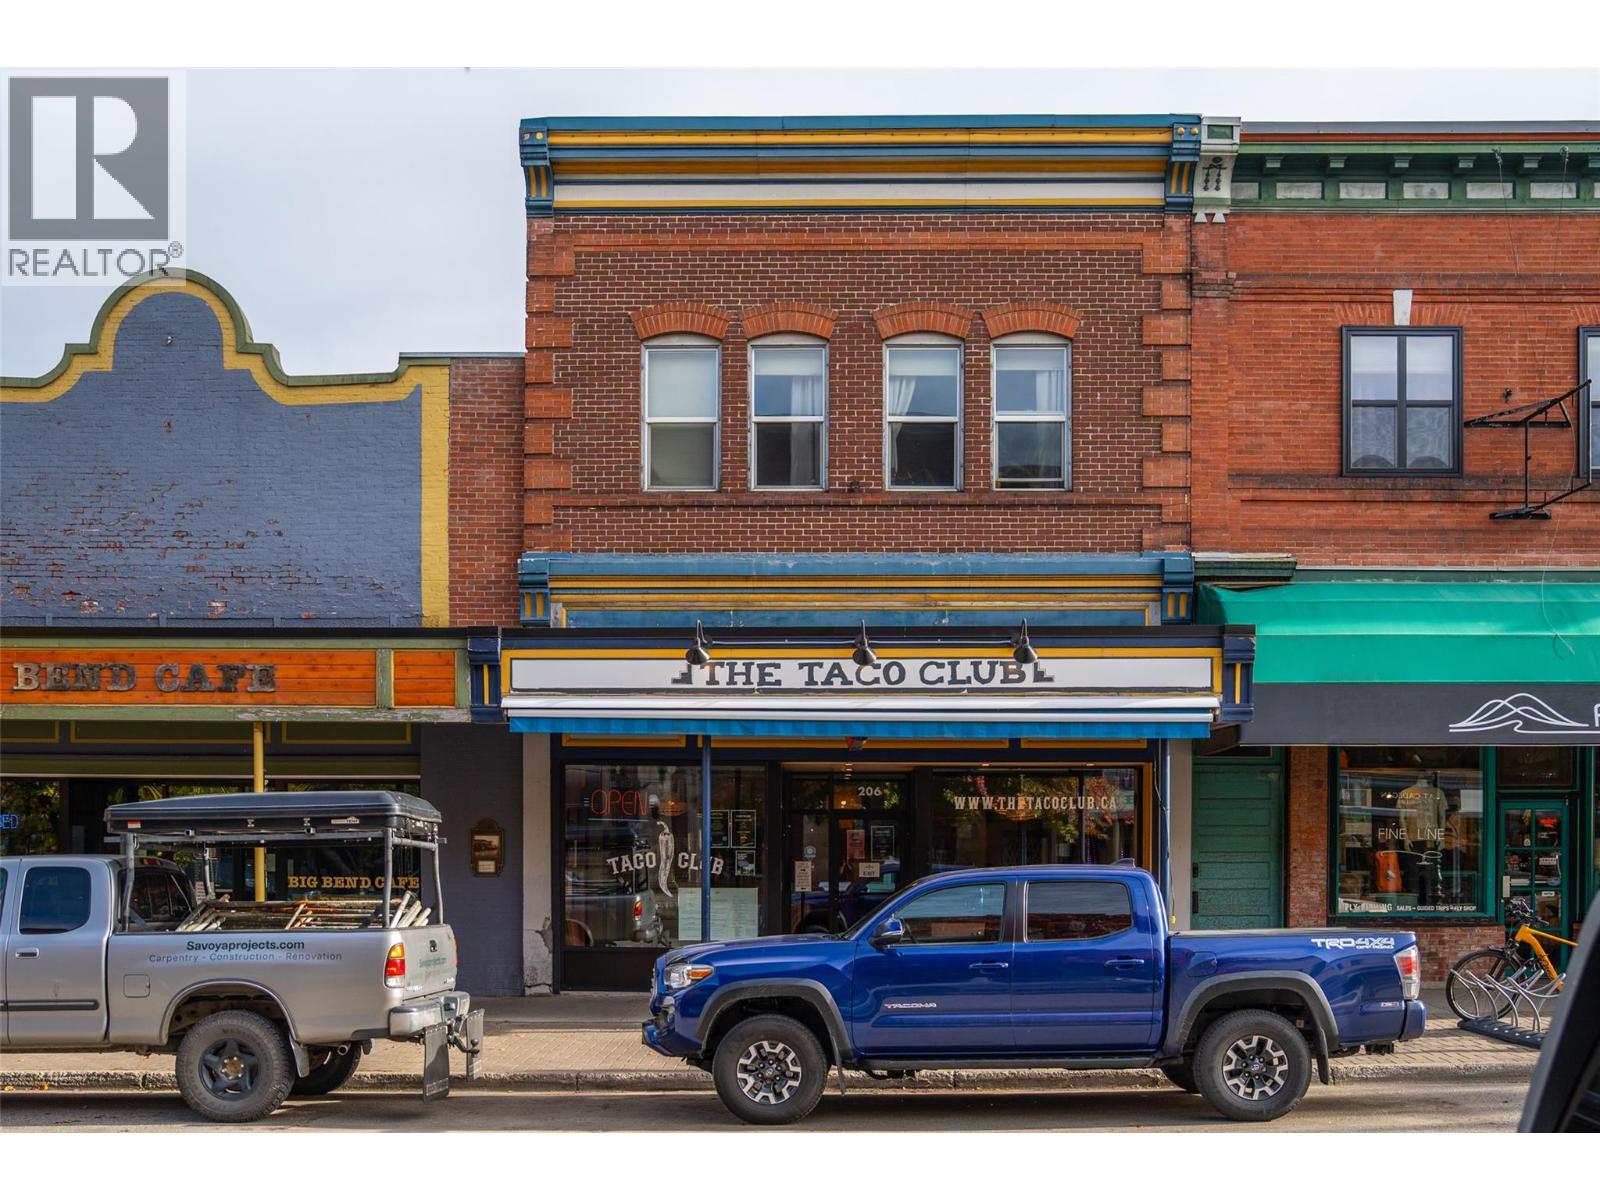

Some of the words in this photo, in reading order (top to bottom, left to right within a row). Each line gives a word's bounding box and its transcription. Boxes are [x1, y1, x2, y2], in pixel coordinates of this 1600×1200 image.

[13, 662, 136, 691] BEND
[155, 663, 276, 692] CAFE
[700, 662, 782, 686] THE
[798, 661, 906, 687] TACO
[919, 660, 1025, 686] CLUB
[858, 786, 881, 797] 206
[591, 789, 648, 816] OPEN
[954, 796, 1117, 810] WWW.THETACOCLUB.CA
[1378, 828, 1407, 840] FINE
[1417, 823, 1445, 840] LINE
[607, 852, 656, 875] TACO
[678, 852, 724, 875] CLB
[287, 876, 318, 888] BIG
[321, 876, 371, 889] BEND
[375, 876, 419, 889] CAFE
[187, 940, 305, 952] Savoyaprojects.com
[1311, 937, 1356, 950] TRD
[149, 954, 198, 963] Carpentry
[210, 952, 275, 961] Construction
[286, 952, 342, 960] Renovation
